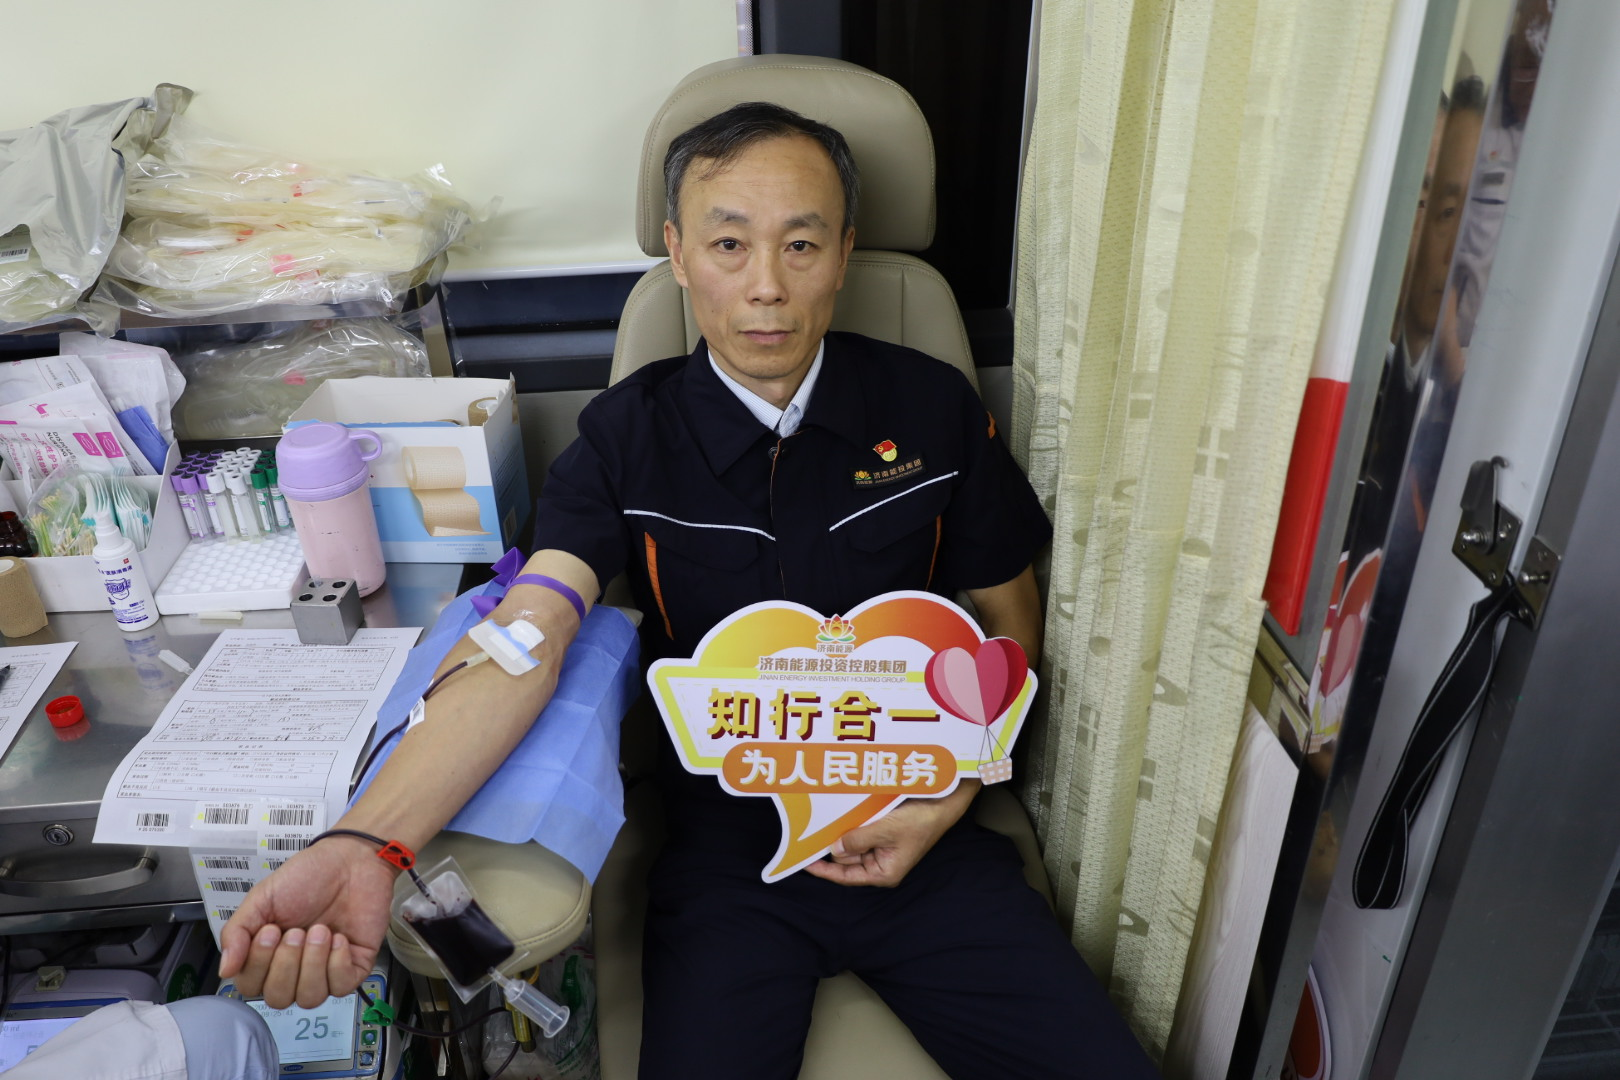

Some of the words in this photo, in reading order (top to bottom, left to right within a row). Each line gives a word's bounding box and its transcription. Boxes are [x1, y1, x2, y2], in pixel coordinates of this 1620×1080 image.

[817, 644, 853, 653] 济南能源
[759, 657, 907, 674] 济南能源投资控股集团
[706, 687, 941, 742] 知行合一
[739, 749, 938, 787] 为人民服务
[294, 1015, 329, 1041] 25
